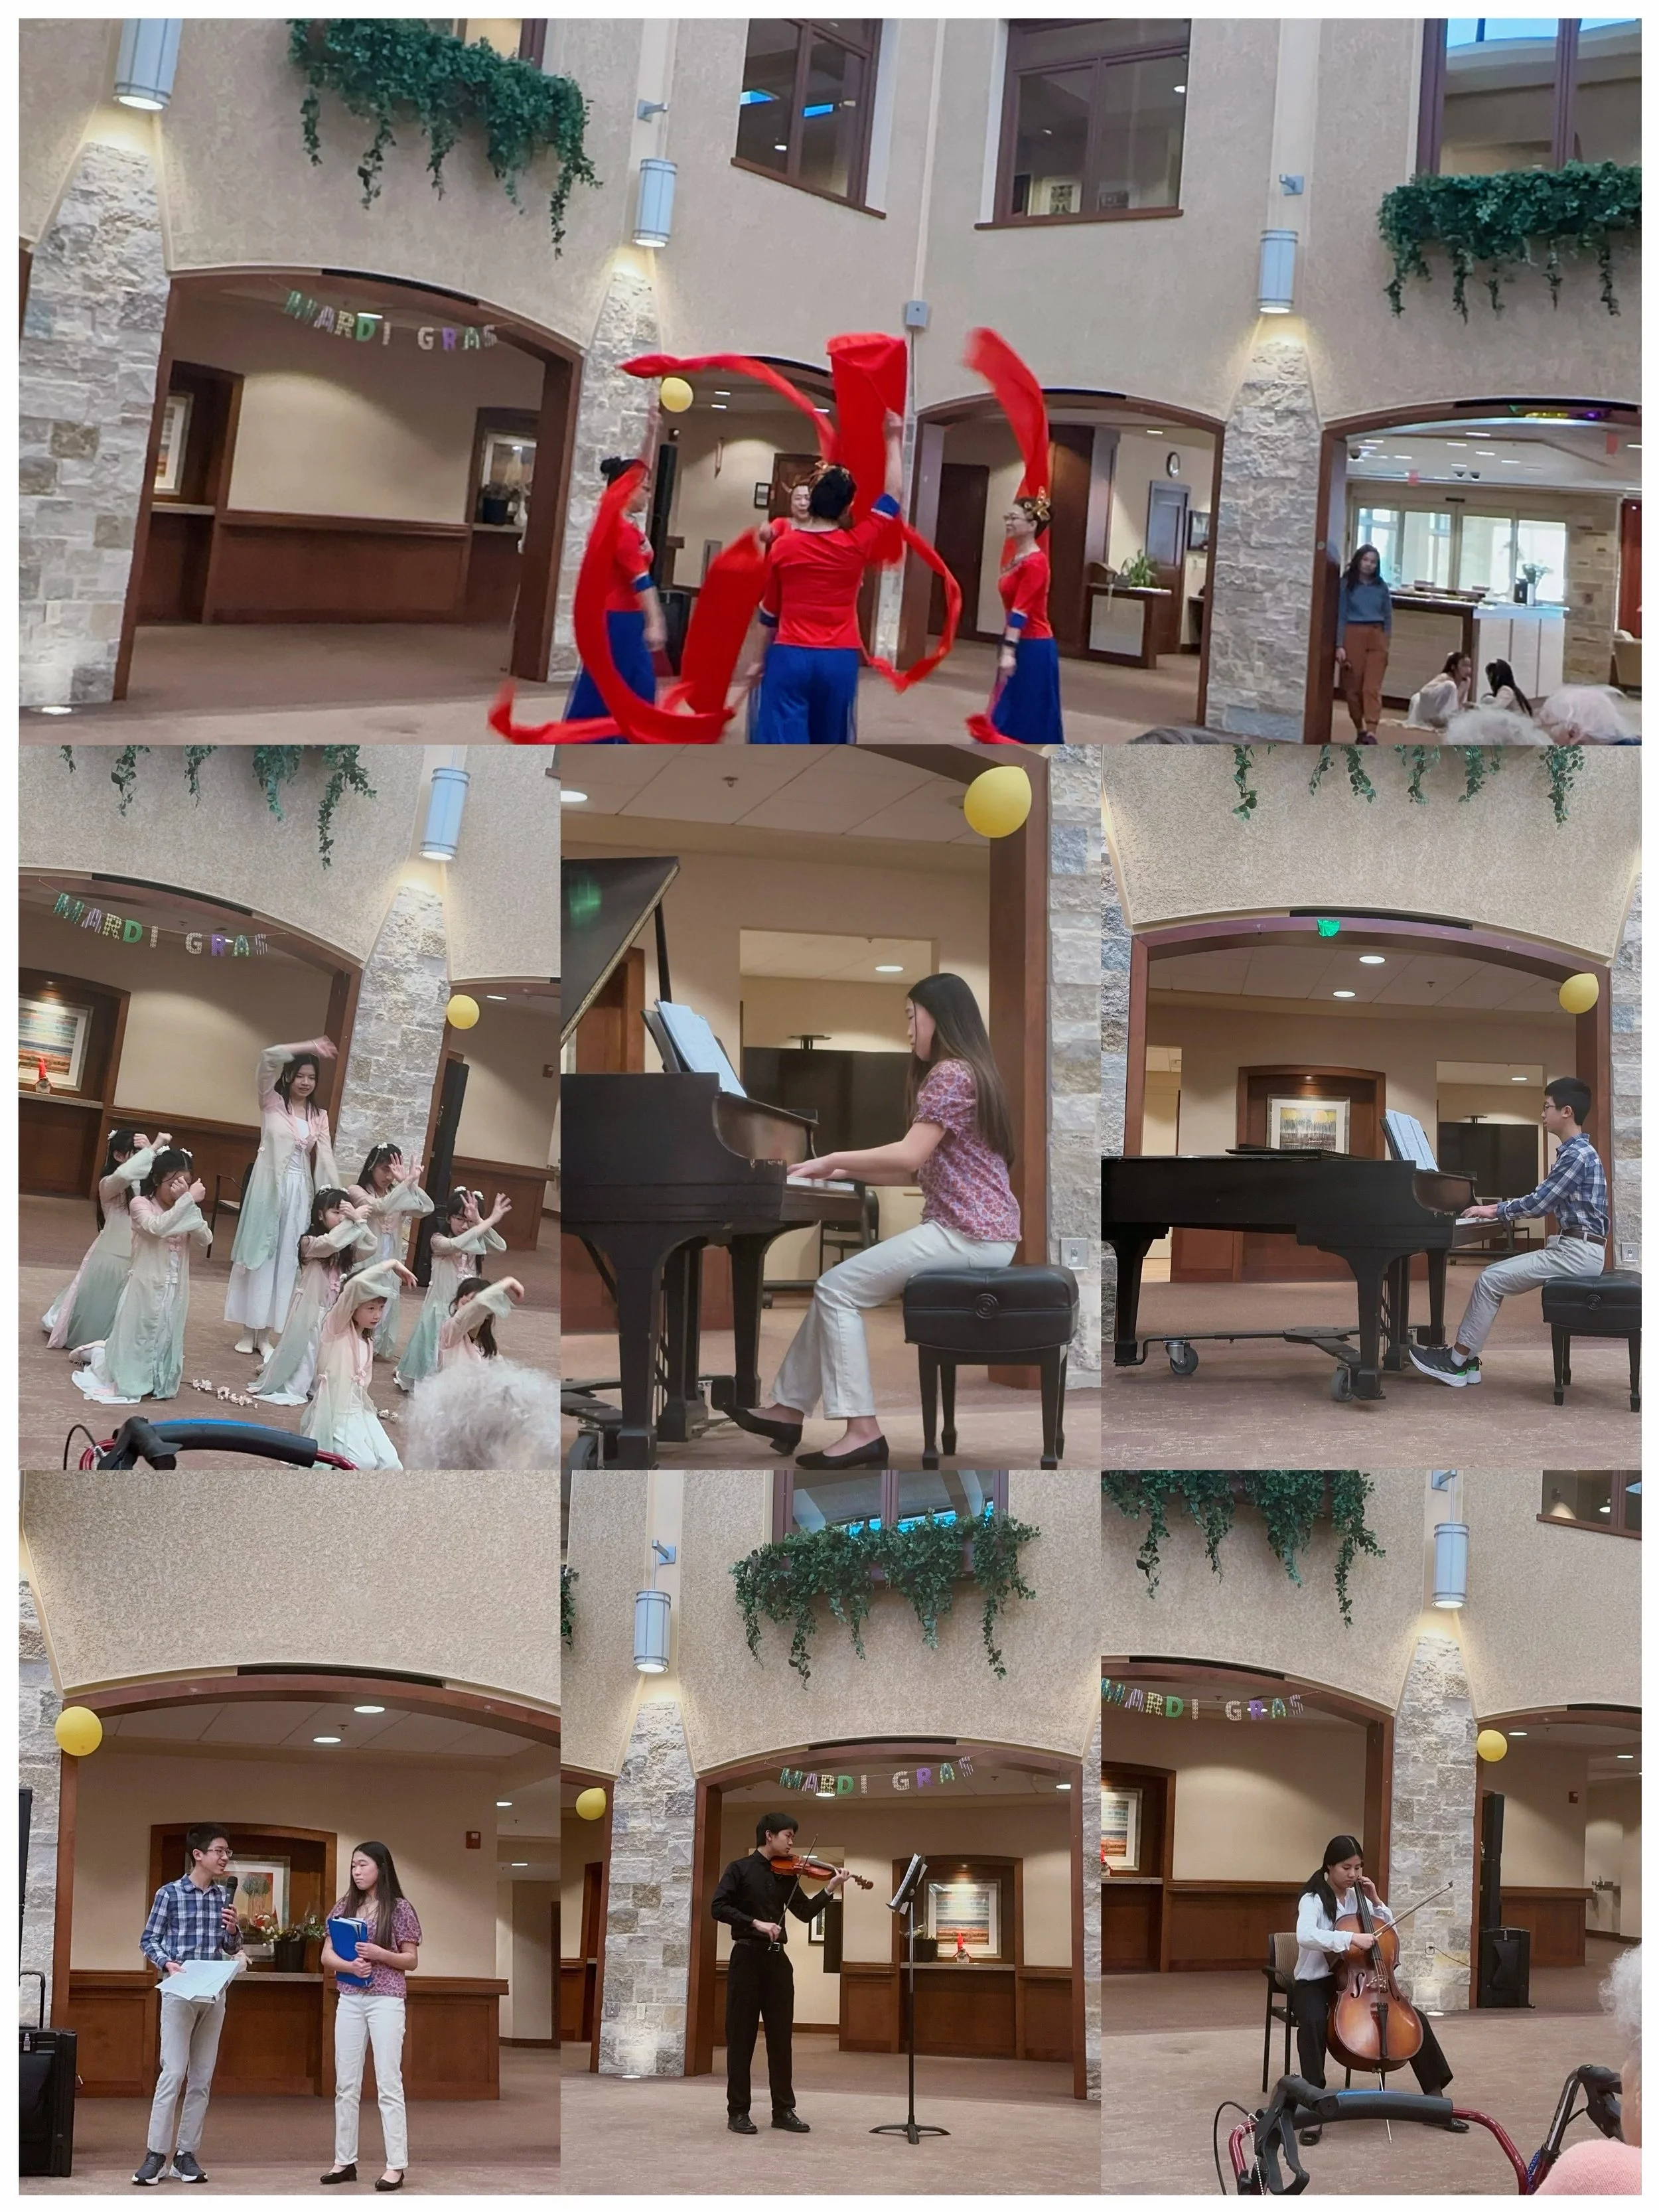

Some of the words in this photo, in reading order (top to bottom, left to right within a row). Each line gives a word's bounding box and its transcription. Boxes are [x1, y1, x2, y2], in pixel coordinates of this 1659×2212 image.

[283, 290, 391, 345] MARDI
[417, 325, 497, 351] GRAS
[52, 893, 159, 948] MARDI
[185, 932, 268, 957] GRAS
[1101, 1677, 1198, 1720] MARDI
[1225, 1694, 1304, 1721] GRAS
[779, 1767, 867, 1795] MARDI
[892, 1755, 974, 1791] GRAS
